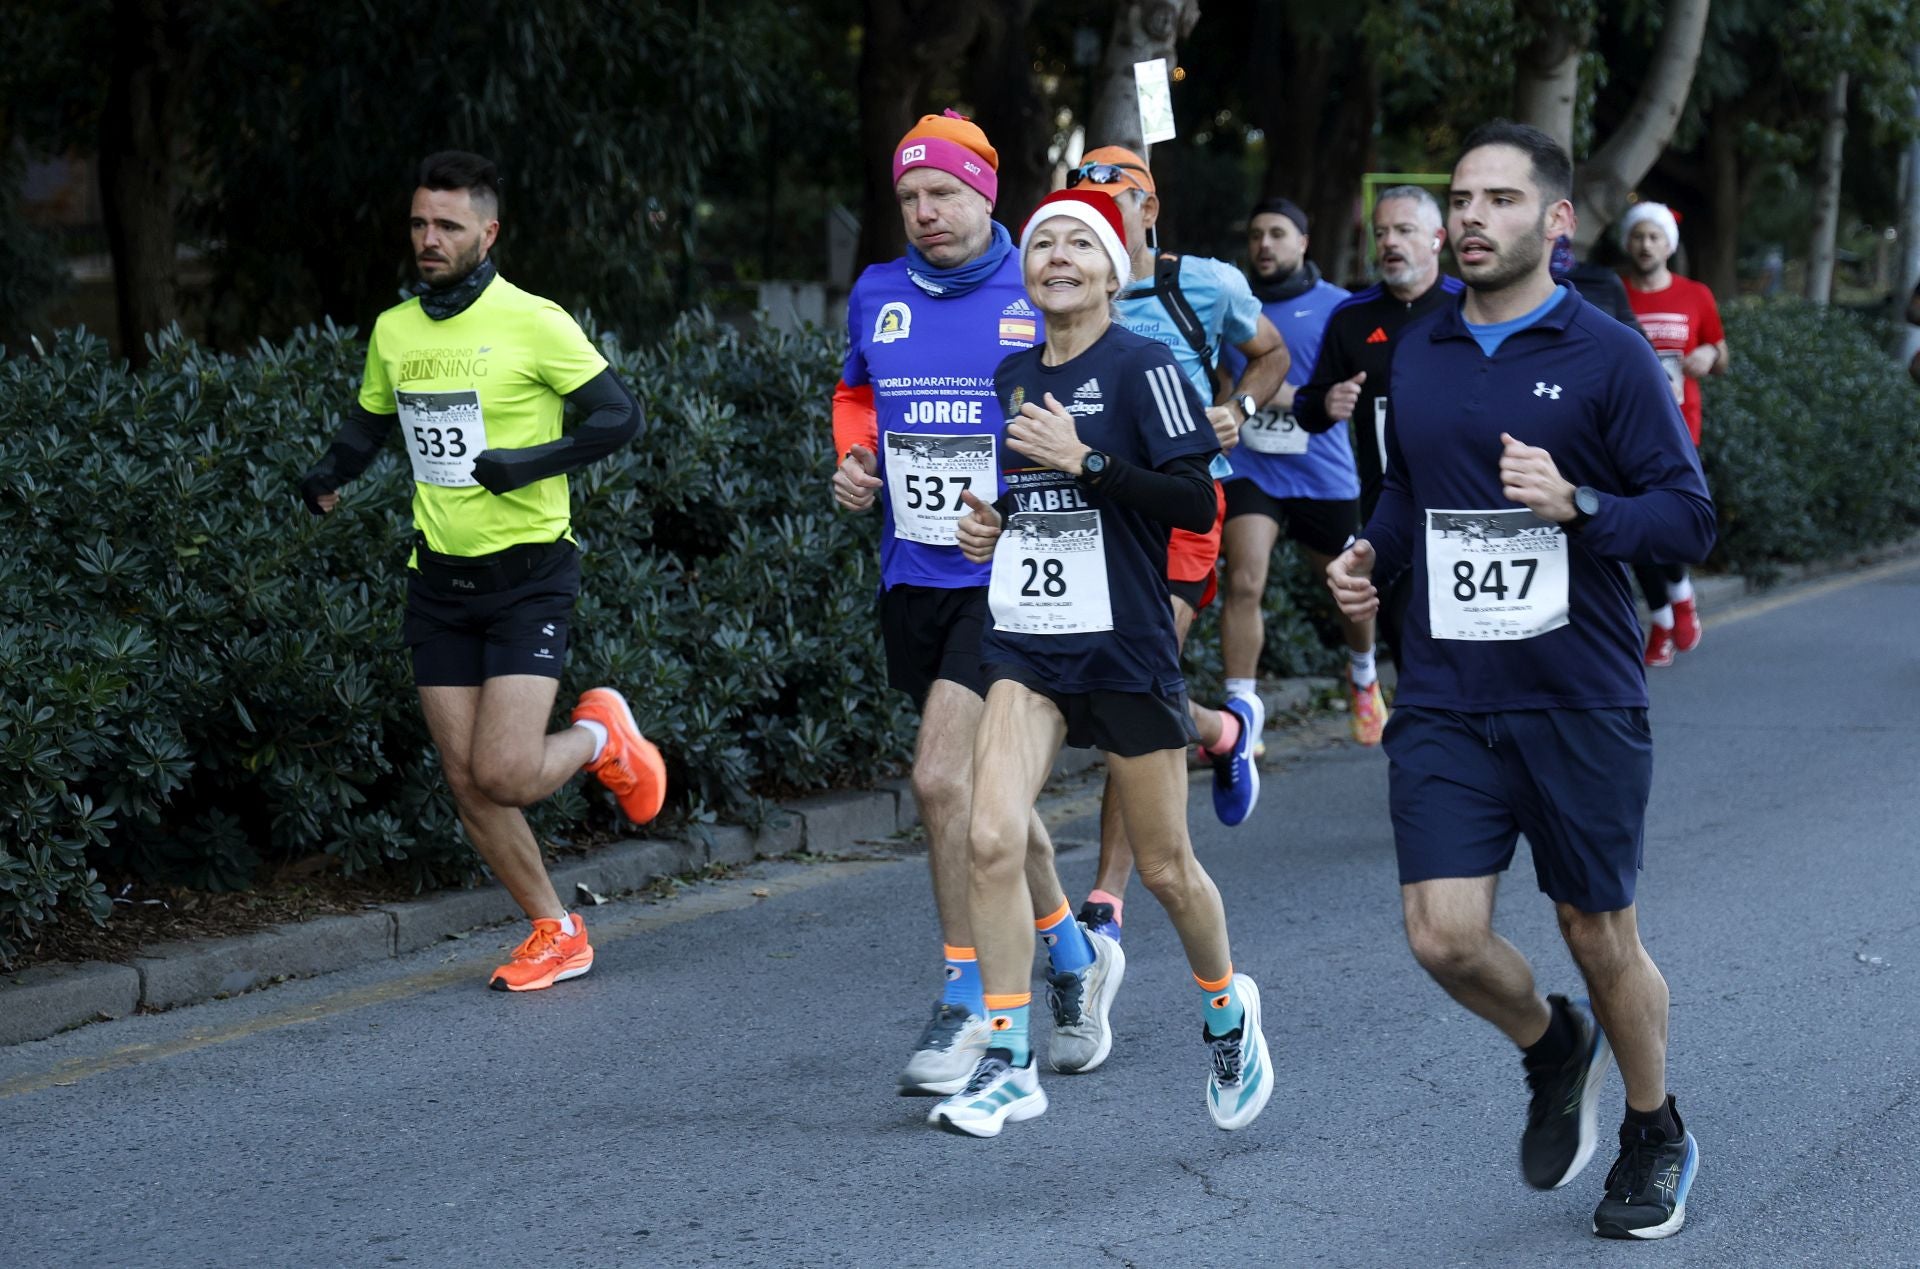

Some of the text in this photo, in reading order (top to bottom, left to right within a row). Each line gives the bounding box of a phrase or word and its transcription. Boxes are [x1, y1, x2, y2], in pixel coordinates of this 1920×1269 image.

[963, 161, 982, 176] 2017
[1002, 309, 1036, 317] adidas
[399, 358, 488, 381] RUNNING
[878, 377, 912, 389] WORLD
[912, 377, 977, 387] MARATHON
[904, 401, 982, 424] JORGE
[1251, 410, 1294, 432] 525
[413, 426, 467, 457] 533
[955, 450, 993, 458] XIV
[906, 474, 972, 511] 537
[1058, 528, 1097, 538] XIV
[1515, 526, 1562, 537] XIV
[452, 579, 475, 589] FILA
[1021, 558, 1066, 597] 28
[1453, 558, 1539, 602] 847
